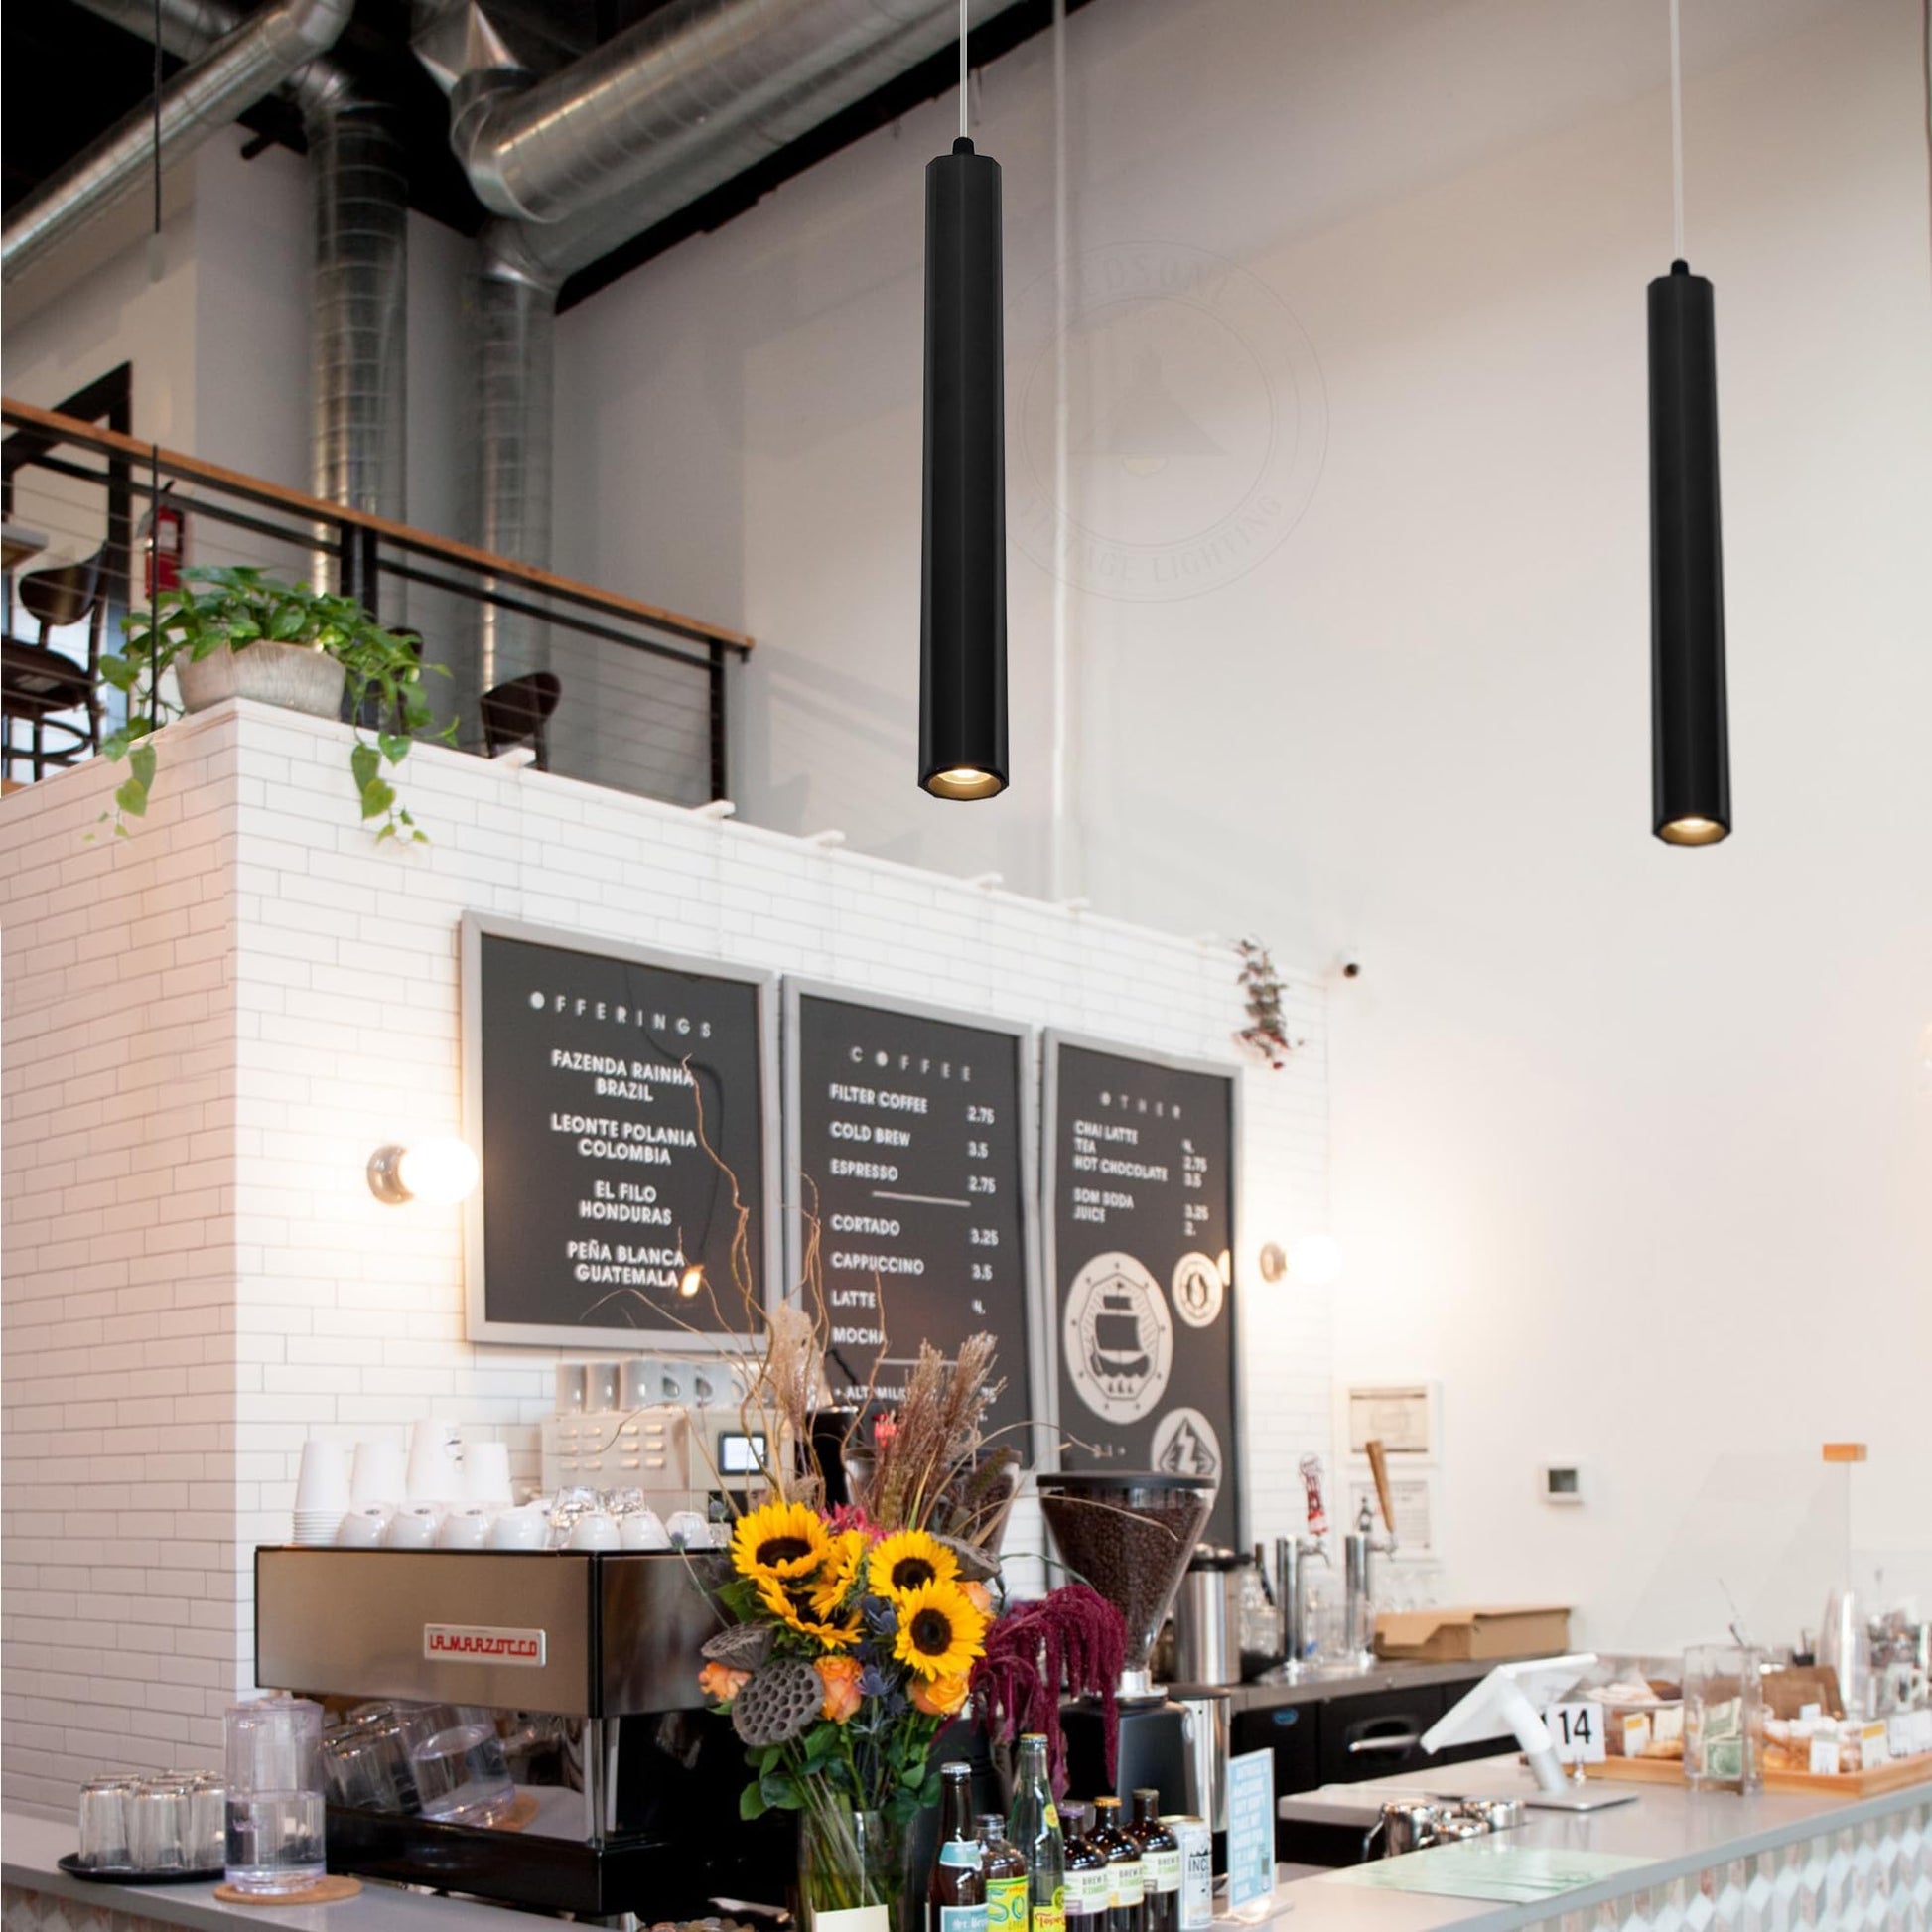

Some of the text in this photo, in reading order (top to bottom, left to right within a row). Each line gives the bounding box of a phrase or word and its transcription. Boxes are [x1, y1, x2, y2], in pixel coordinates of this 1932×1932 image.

[550, 1048, 627, 1078] FAZENDA
[851, 1046, 971, 1082] COFFEE
[596, 1078, 653, 1102] BRAZIL
[830, 1083, 995, 1124] FILTER COFFEE 2.75
[549, 1113, 697, 1148] LEONTE POLANIA
[830, 1121, 988, 1159] COLD BREW 3.5
[1105, 1125, 1139, 1144] LATTE
[579, 1140, 672, 1165] COLOMBIA
[1074, 1138, 1096, 1153] TEA
[830, 1159, 996, 1193] ESPRESSO 2.75
[1074, 1155, 1098, 1172] HOT
[1100, 1160, 1169, 1181] CHOCOLATE
[596, 1180, 656, 1203] EL FILO
[1103, 1192, 1135, 1209] SODA
[580, 1201, 672, 1226] HONDURAS
[1074, 1207, 1106, 1223] JUICE
[830, 1214, 999, 1246] CORTADO 3.25
[567, 1240, 685, 1267] PEÑA BLANCA
[575, 1265, 678, 1288] GUATEMALA
[830, 1252, 993, 1281] CAPPUCCINO 3.5
[831, 1291, 876, 1308] LATTE
[846, 1386, 870, 1399] ALT
